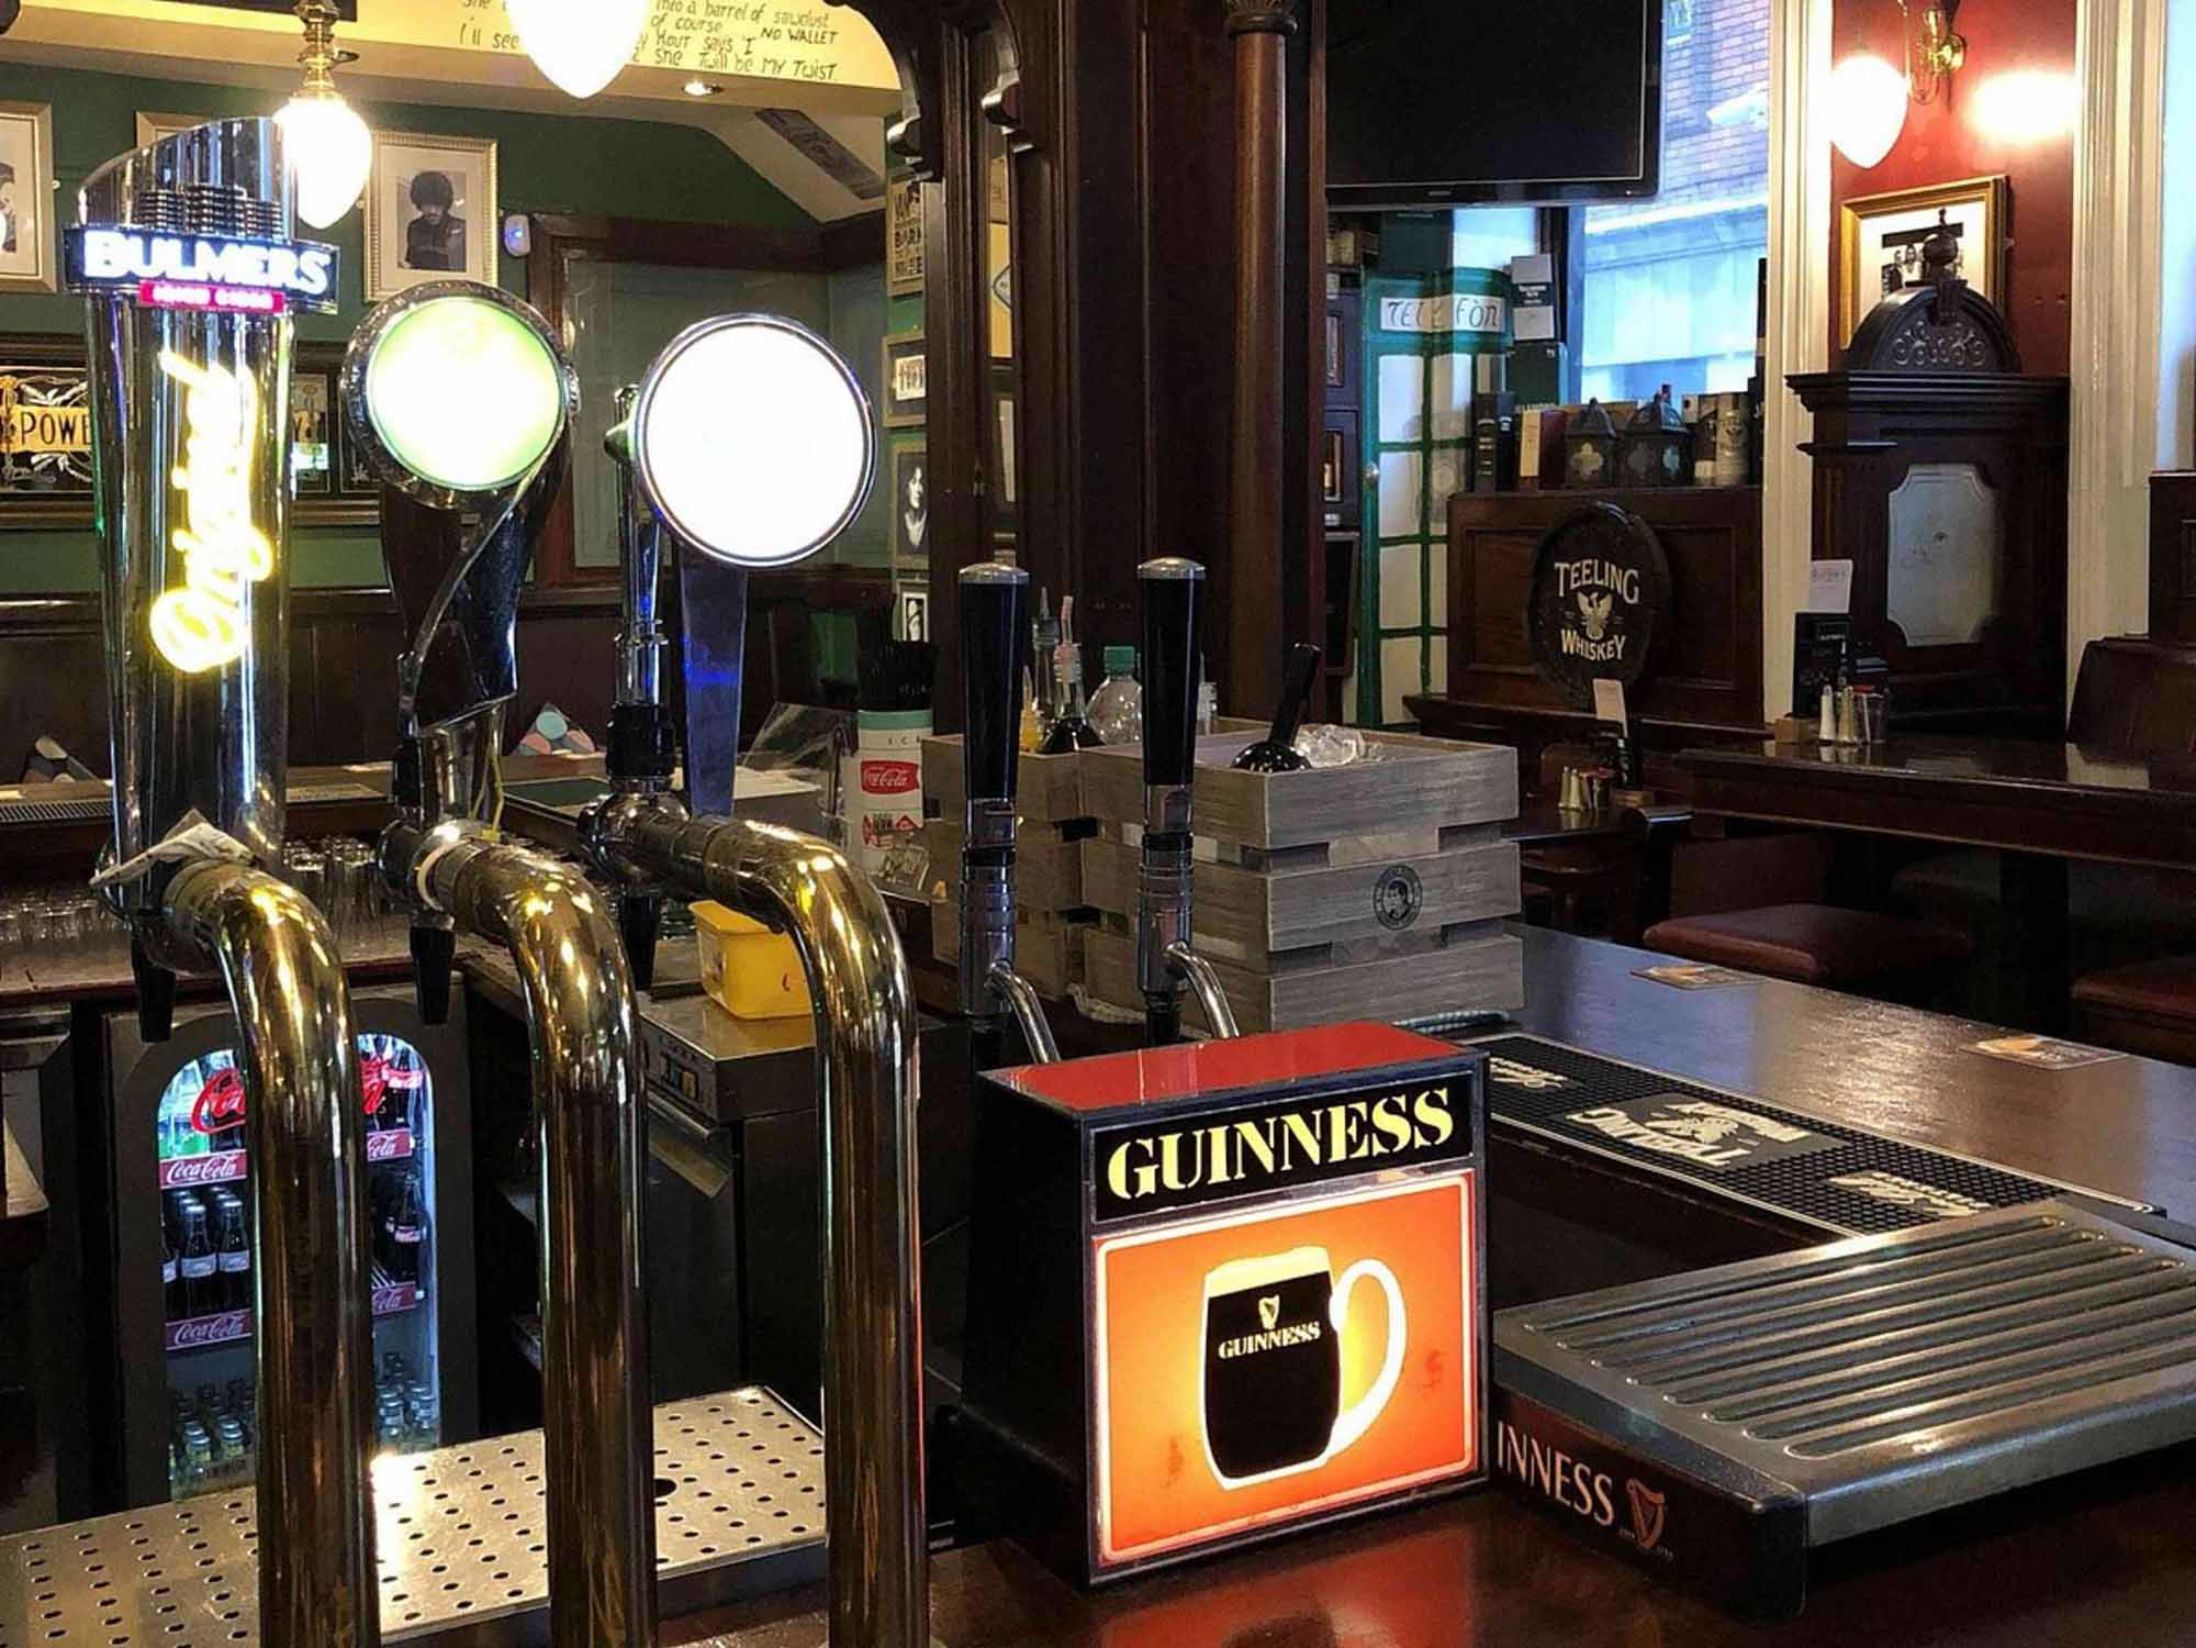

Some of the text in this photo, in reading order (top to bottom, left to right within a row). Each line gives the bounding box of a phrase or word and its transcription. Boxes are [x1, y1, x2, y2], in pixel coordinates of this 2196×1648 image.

[760, 27, 840, 45] NO WALLET
[84, 230, 332, 296] BULMERS
[20, 411, 92, 446] POWE
[1553, 558, 1640, 605] TEELING
[1561, 627, 1627, 661] WHISKEY
[1107, 1087, 1455, 1200] GUINNESS
[1218, 1320, 1321, 1360] GUINNESS
[1498, 1419, 1616, 1526] INNESS
